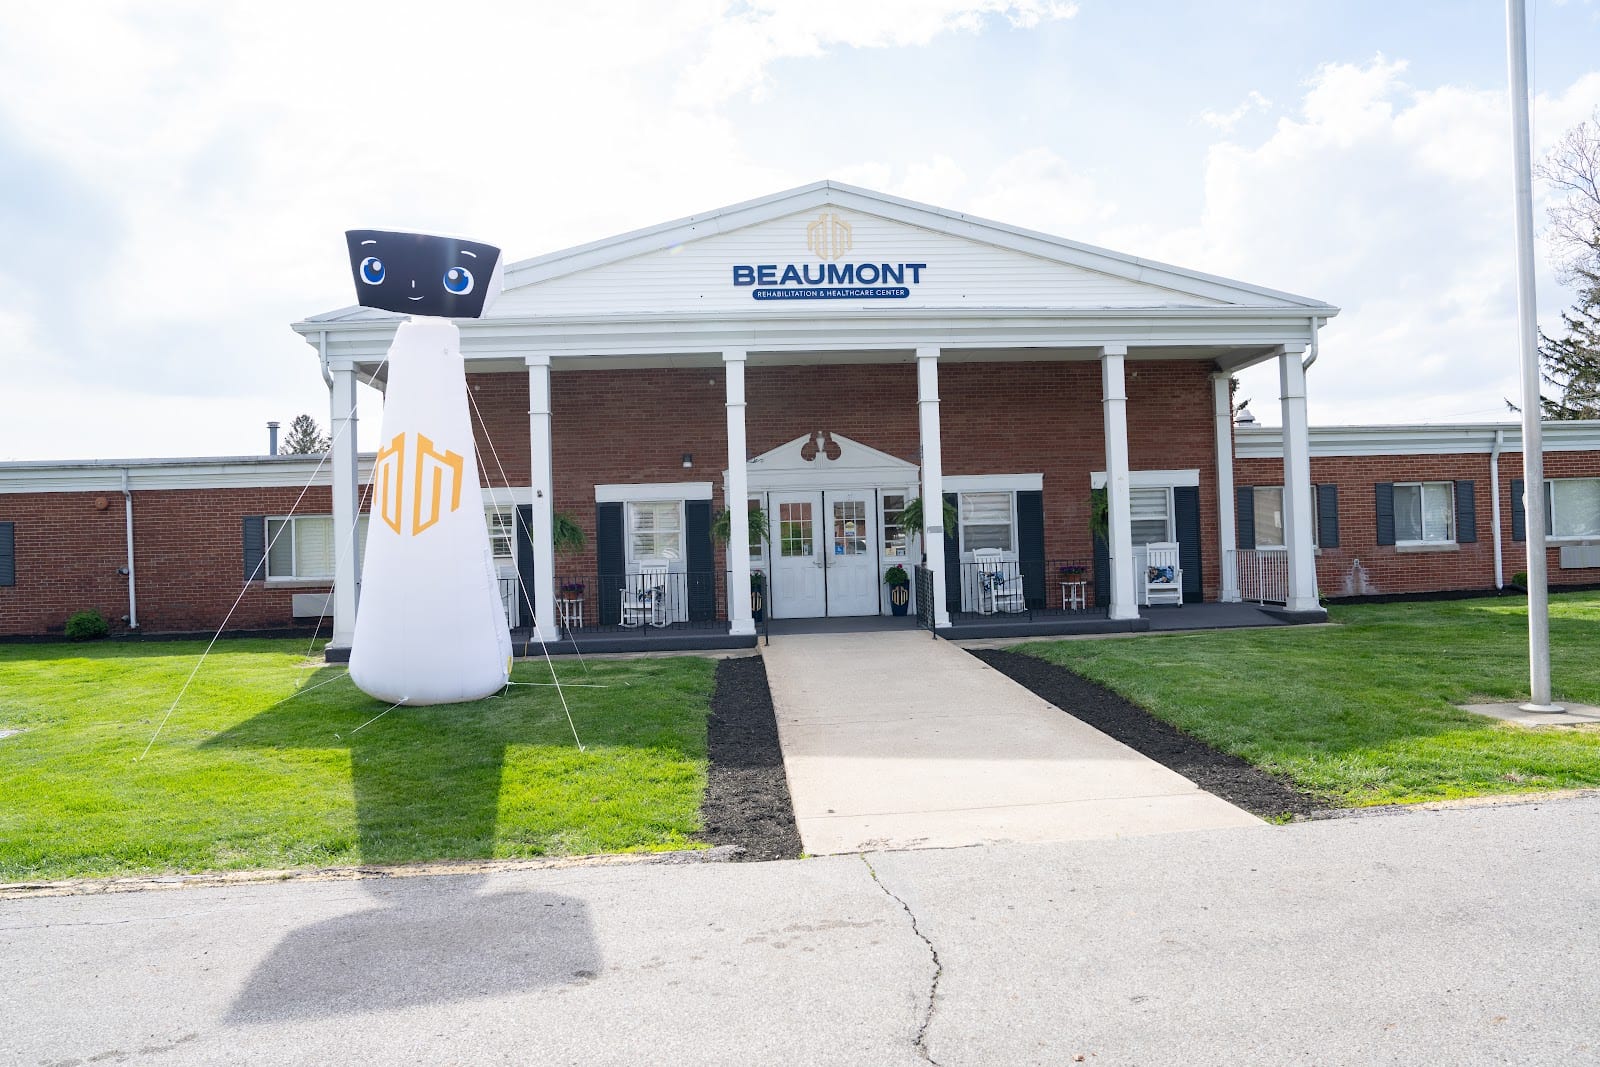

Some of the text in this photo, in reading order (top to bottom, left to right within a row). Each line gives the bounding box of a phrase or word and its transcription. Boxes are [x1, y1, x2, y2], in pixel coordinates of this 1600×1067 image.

[733, 264, 927, 286] BEAUMONT
[757, 290, 817, 298] REHABILITATION
[826, 289, 874, 297] HEALTHCARE
